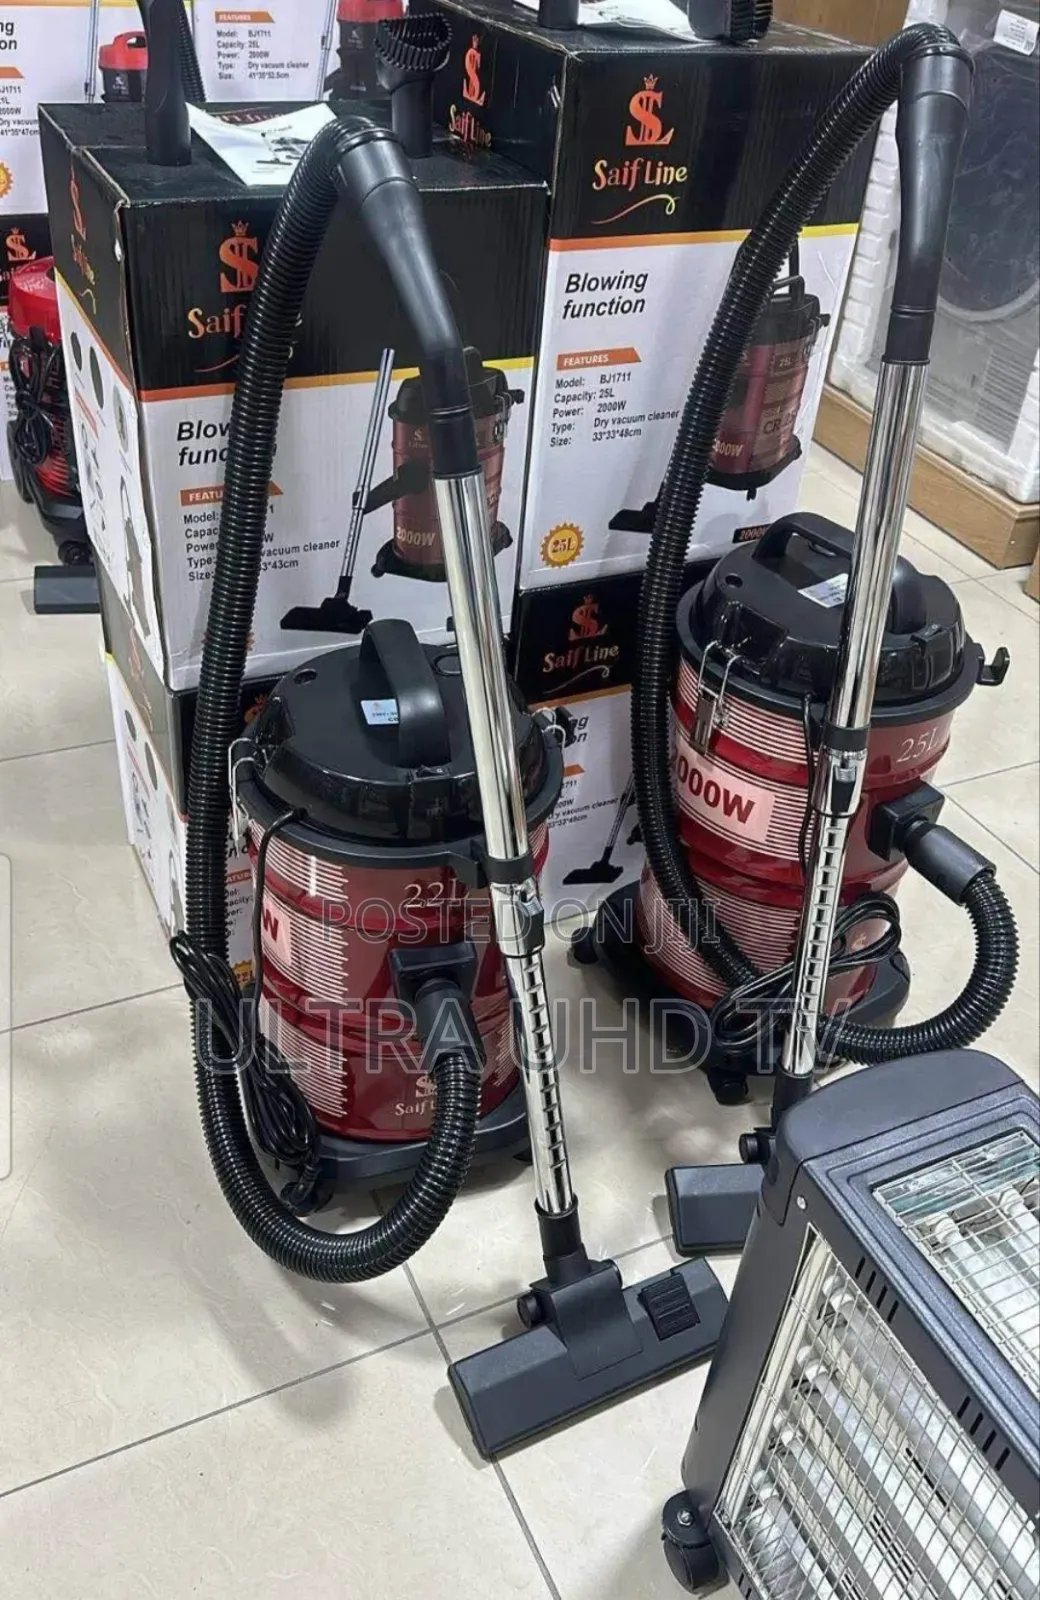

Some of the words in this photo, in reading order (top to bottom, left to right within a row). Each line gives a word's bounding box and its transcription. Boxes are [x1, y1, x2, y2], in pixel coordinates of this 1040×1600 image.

[592, 157, 643, 192] Saif
[644, 160, 688, 186] Line
[565, 270, 649, 294] Blowing
[562, 296, 646, 320] function
[187, 304, 247, 339] Saif
[563, 354, 609, 367] FEATURES
[555, 377, 586, 390] Model:
[599, 371, 631, 385] BJ1711
[553, 391, 597, 404] Capacity:
[598, 388, 615, 400] 25L
[552, 406, 584, 419] Power:
[597, 400, 627, 413] 2000W
[551, 422, 576, 434] Type:
[593, 417, 610, 430] Dry
[611, 413, 646, 426] vacuum
[647, 409, 680, 422] cleaner
[549, 437, 572, 448] Size:
[183, 511, 220, 524] Model:
[396, 525, 437, 547] 2000W
[552, 536, 575, 553] 25L
[303, 540, 341, 553] cleaner
[542, 647, 581, 673] Saif
[583, 645, 620, 663] Line
[677, 755, 756, 825] 000W
